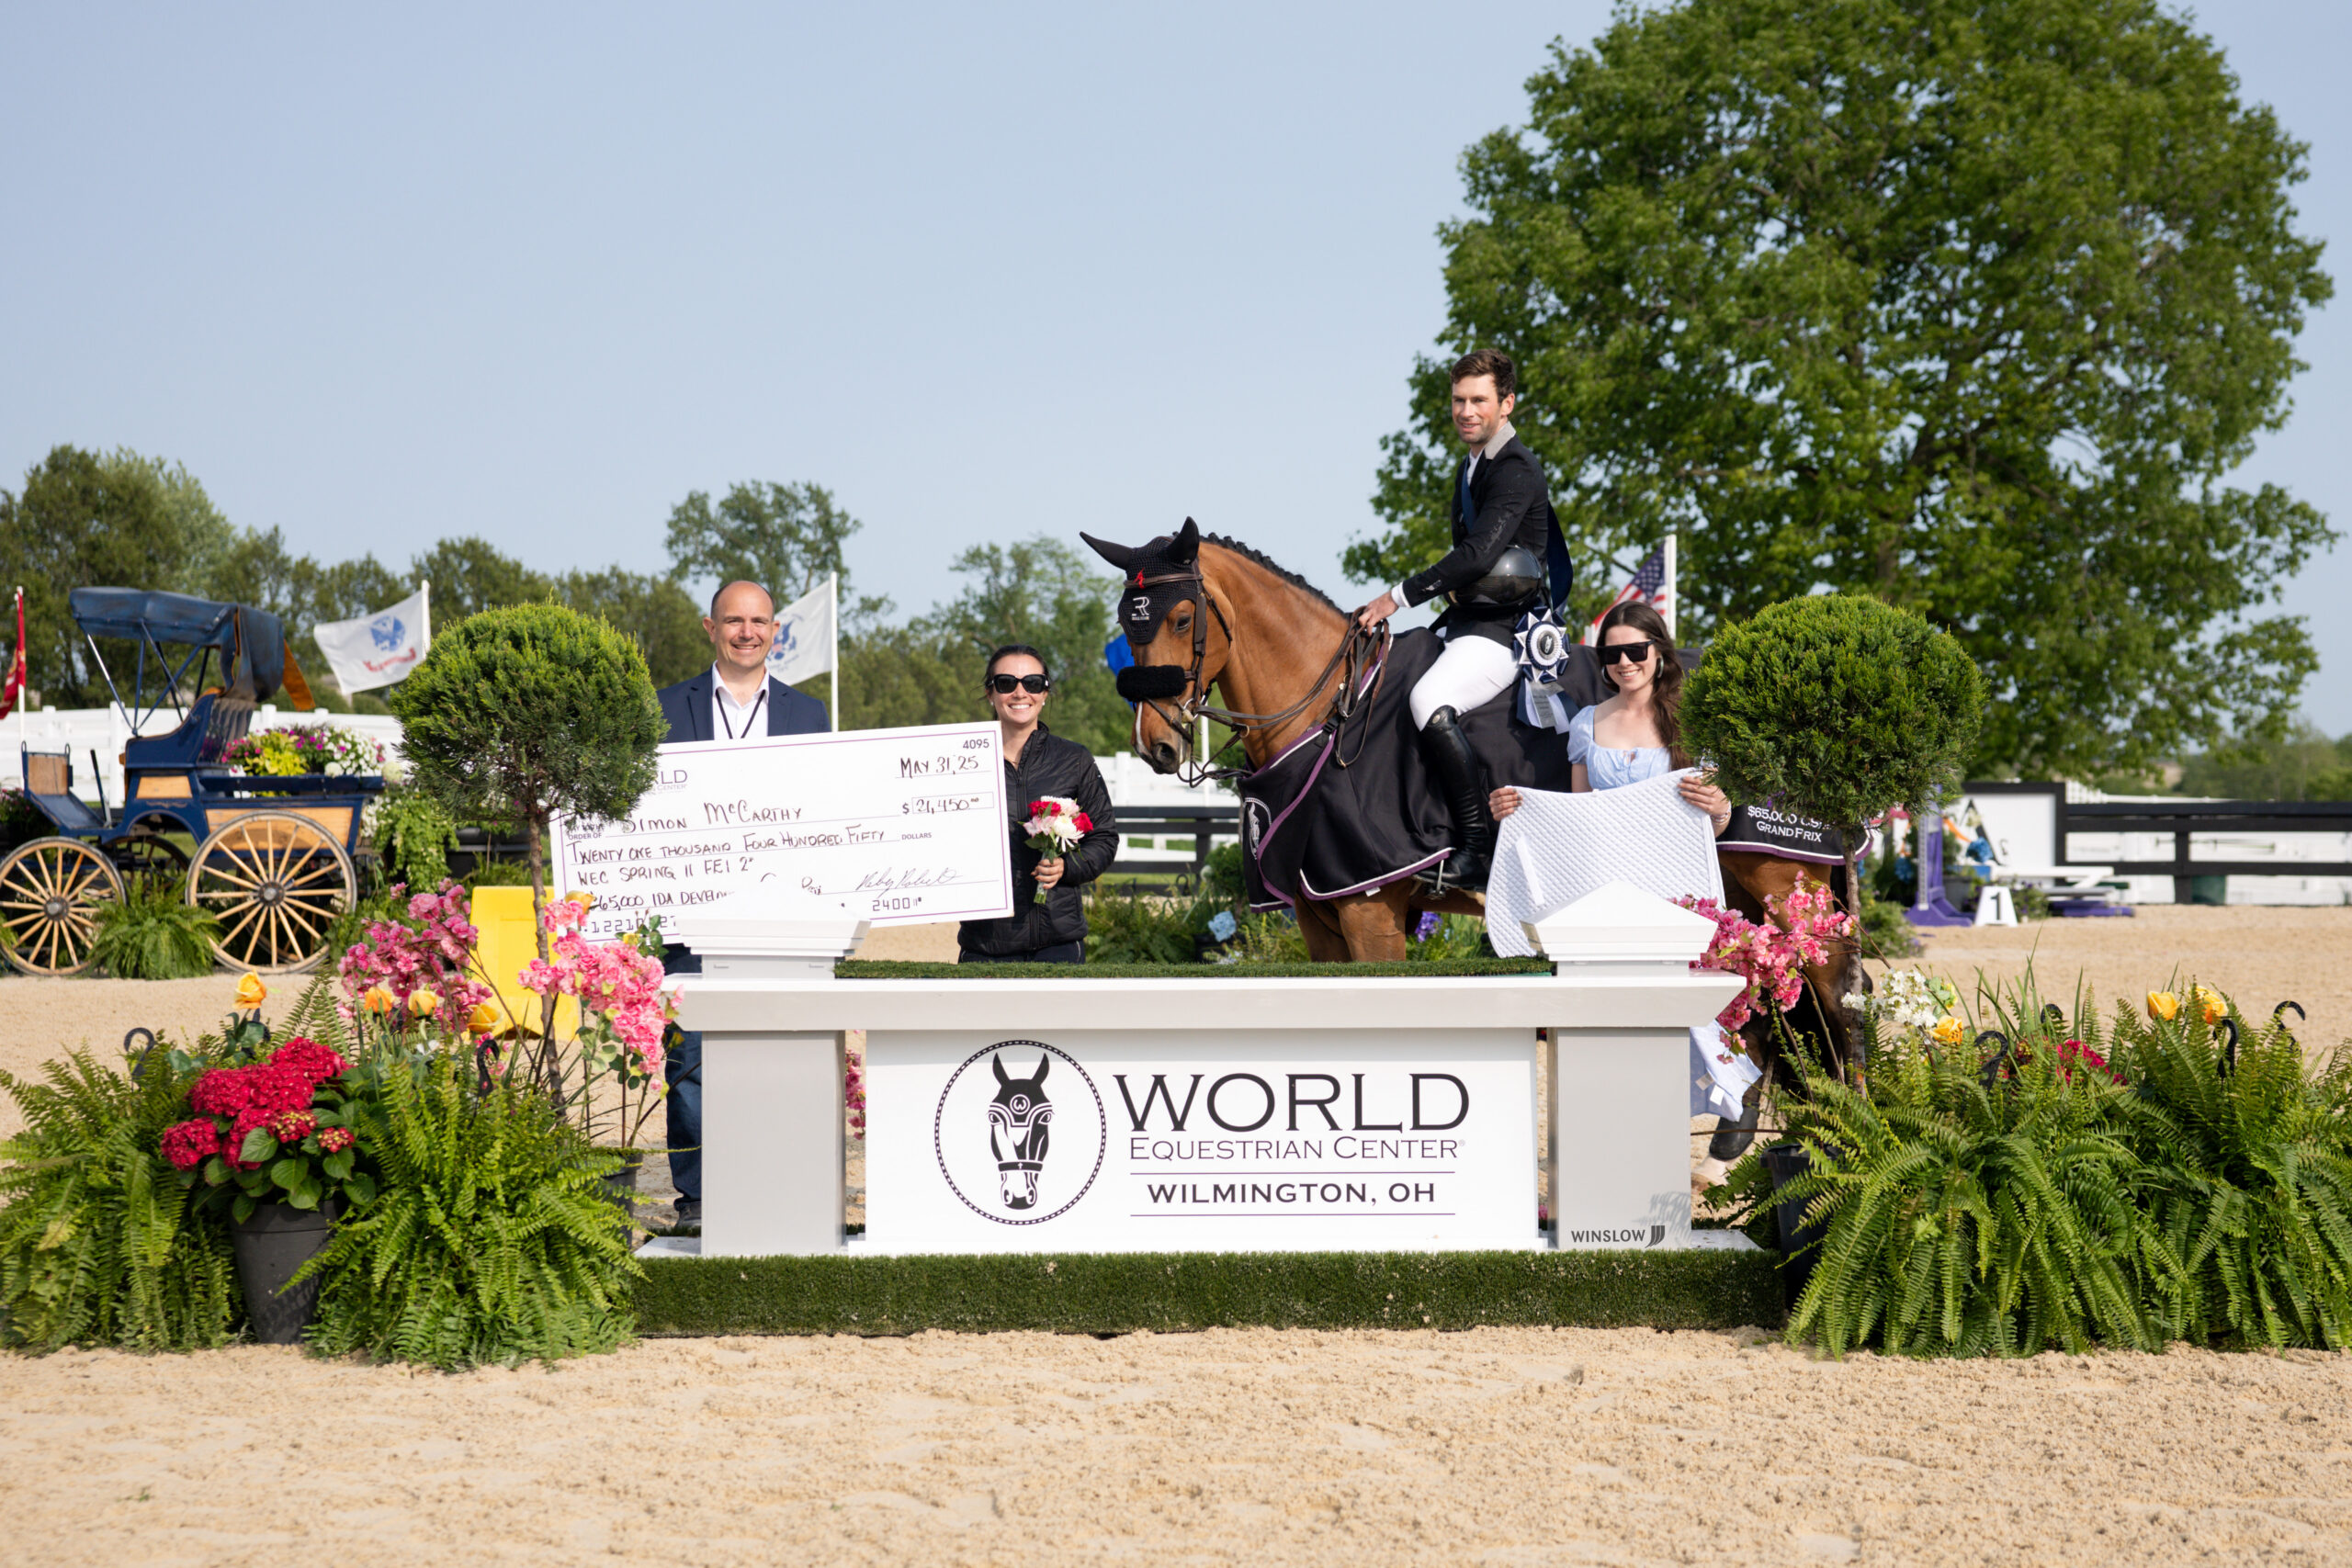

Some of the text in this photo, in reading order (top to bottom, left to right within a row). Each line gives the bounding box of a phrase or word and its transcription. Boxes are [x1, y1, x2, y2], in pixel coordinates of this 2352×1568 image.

[963, 739, 989, 750] 4095
[900, 757, 929, 779] MAY
[901, 832, 933, 840] DOLLARS
[1756, 820, 1794, 837] GRAND
[566, 824, 885, 864] TWENTY ONE THOUSAND FOUR HUNDRED FIFTY
[577, 871, 609, 886] WEC
[619, 866, 676, 883] SPRING
[705, 859, 729, 875] FEI
[652, 892, 674, 907] IDA
[1990, 892, 2001, 920] 1
[1113, 1073, 1470, 1133] WORLD
[1129, 1137, 1323, 1162] EQUESTRIAN
[1148, 1182, 1435, 1206] WILMINGTON, OH
[1571, 1229, 1645, 1243] WINSLOW
